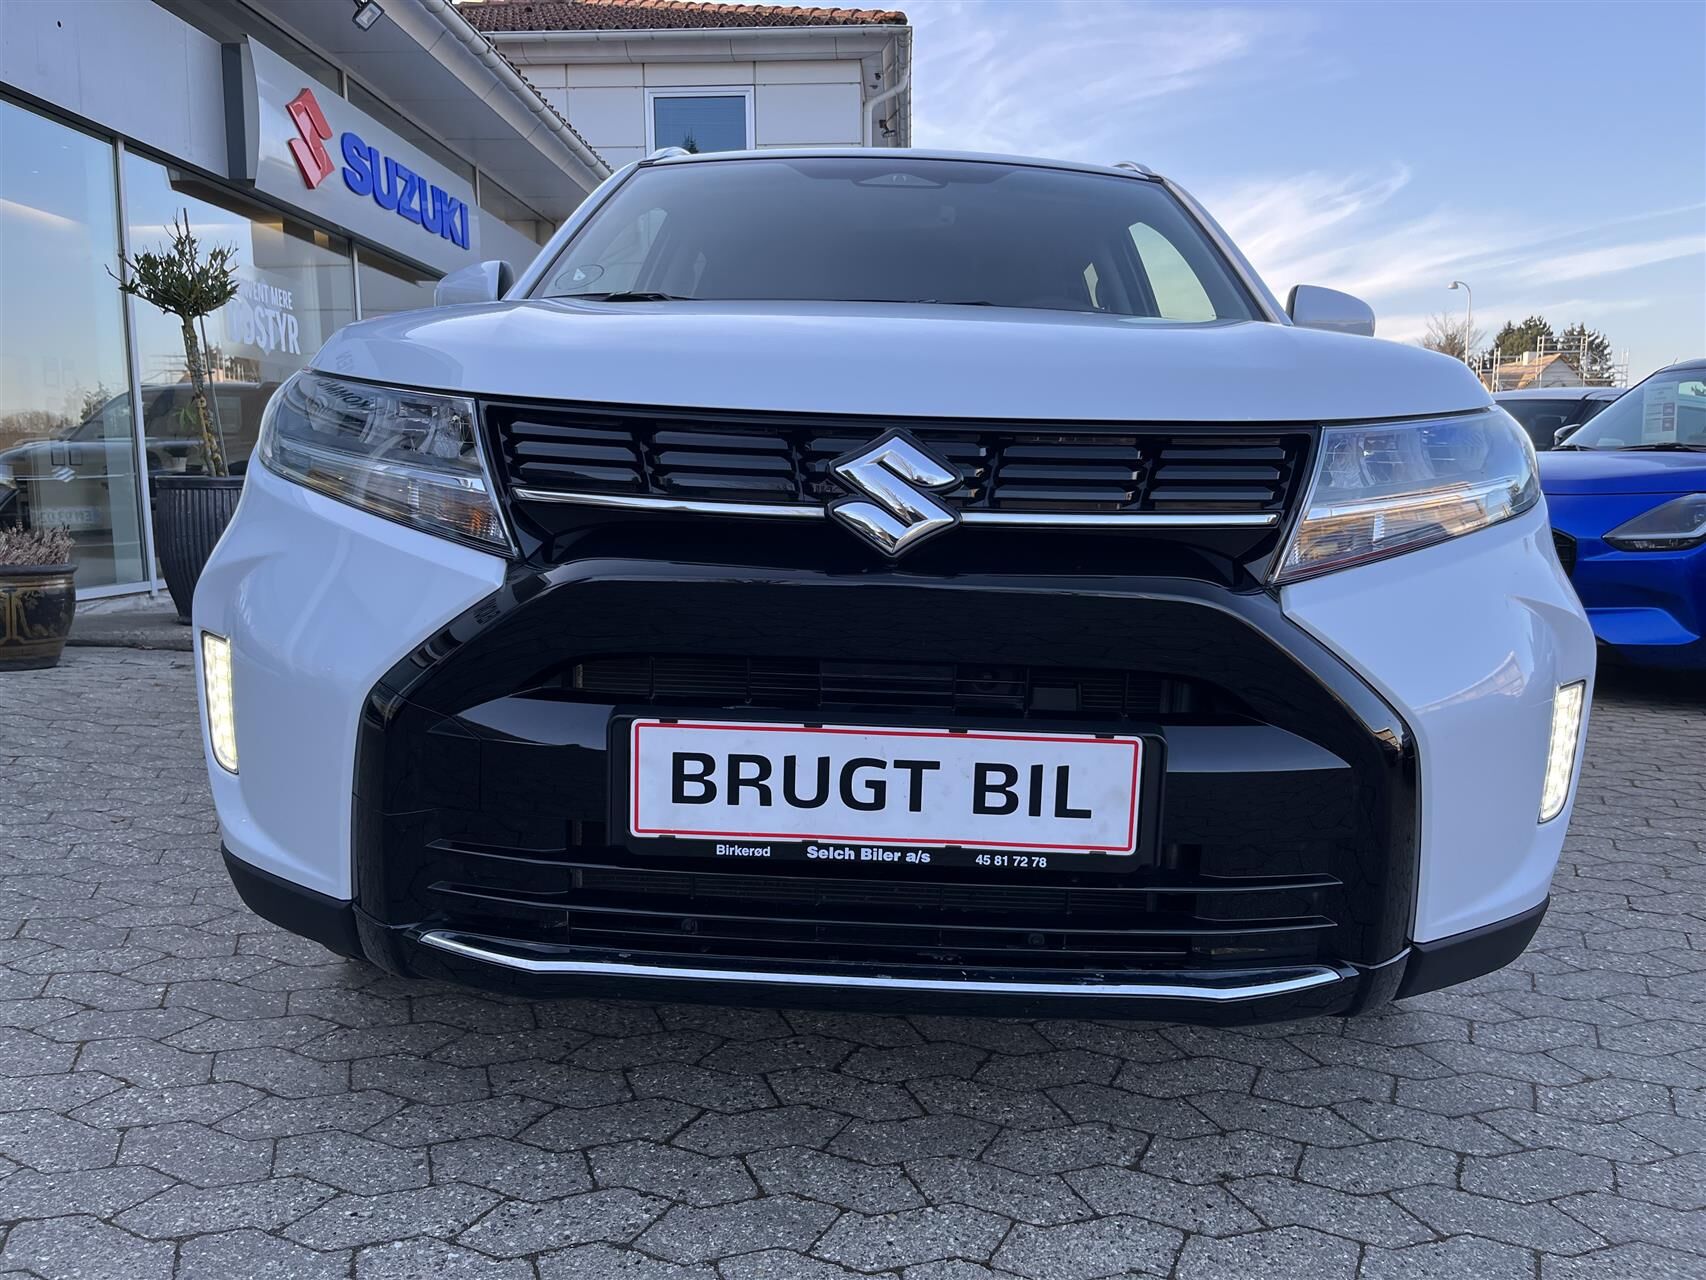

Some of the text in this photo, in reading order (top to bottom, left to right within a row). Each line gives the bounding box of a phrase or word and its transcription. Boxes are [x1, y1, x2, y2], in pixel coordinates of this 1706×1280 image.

[341, 132, 470, 250] SUZUKI
[270, 285, 294, 311] MERE
[671, 751, 1093, 820] BRUGT BIL
[716, 844, 771, 857] Birkerød
[806, 845, 931, 864] Selch Biler a/s
[975, 854, 1047, 868] 45 81 72 78
